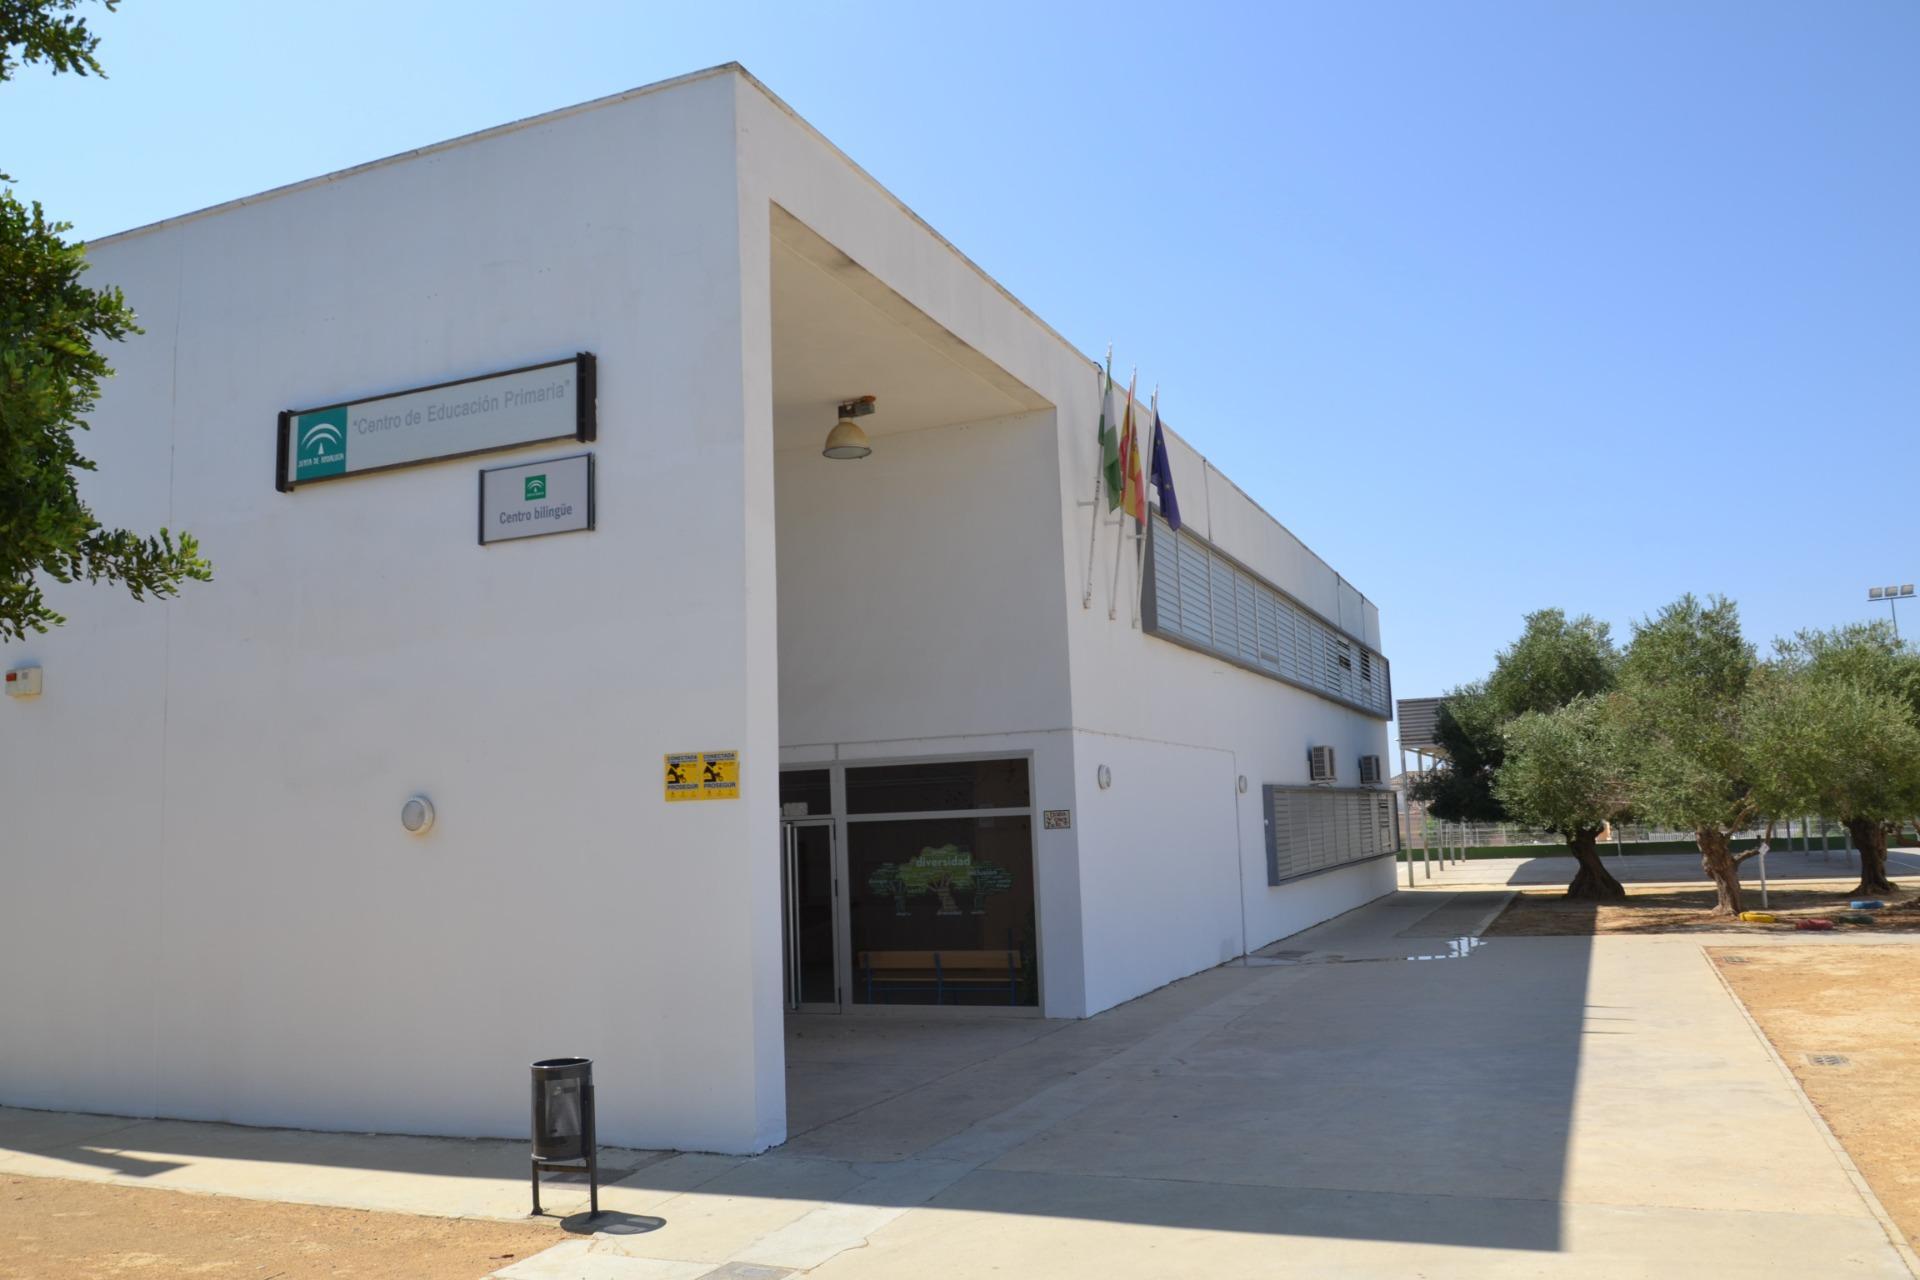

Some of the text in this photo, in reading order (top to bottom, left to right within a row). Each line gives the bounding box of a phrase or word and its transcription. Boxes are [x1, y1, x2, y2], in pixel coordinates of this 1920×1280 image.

[405, 408, 421, 427] de
[428, 394, 498, 423] Educación
[499, 503, 573, 525] Centro bilingüe
[915, 855, 971, 867] diversidad
